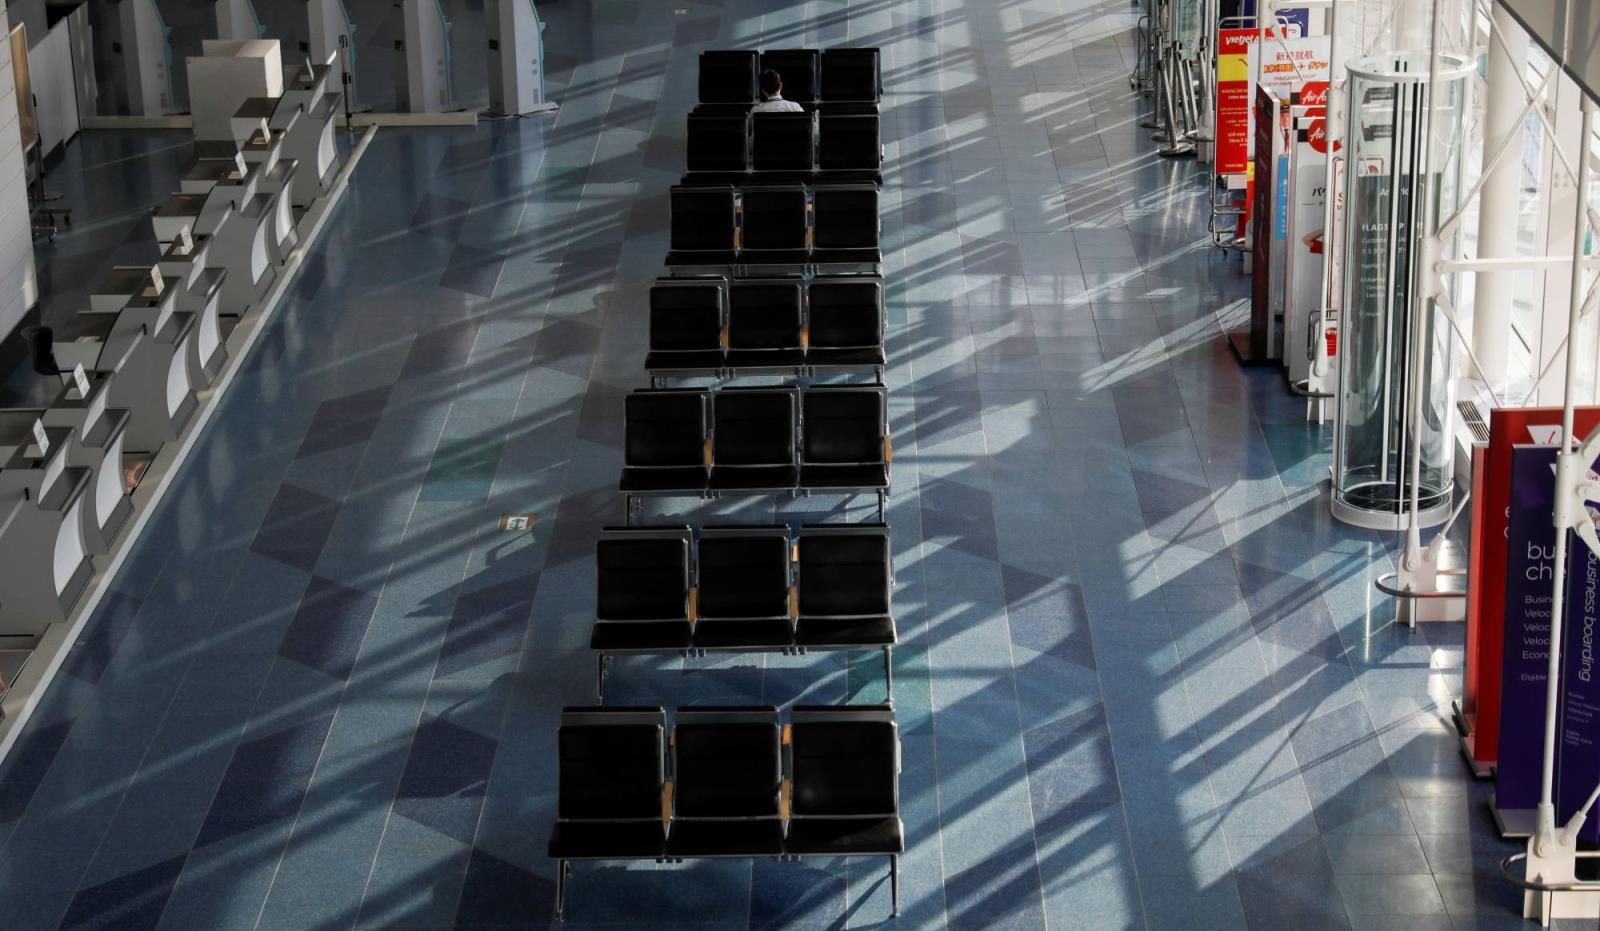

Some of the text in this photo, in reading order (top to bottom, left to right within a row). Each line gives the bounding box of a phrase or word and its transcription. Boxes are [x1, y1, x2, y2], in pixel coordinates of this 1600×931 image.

[1525, 595, 1554, 604] Busin
[1524, 609, 1552, 618] Veloc
[1524, 623, 1552, 632] Veloc
[1523, 637, 1550, 646] Veloc
[1579, 617, 1597, 682] boarding
[1522, 650, 1551, 660] Econo
